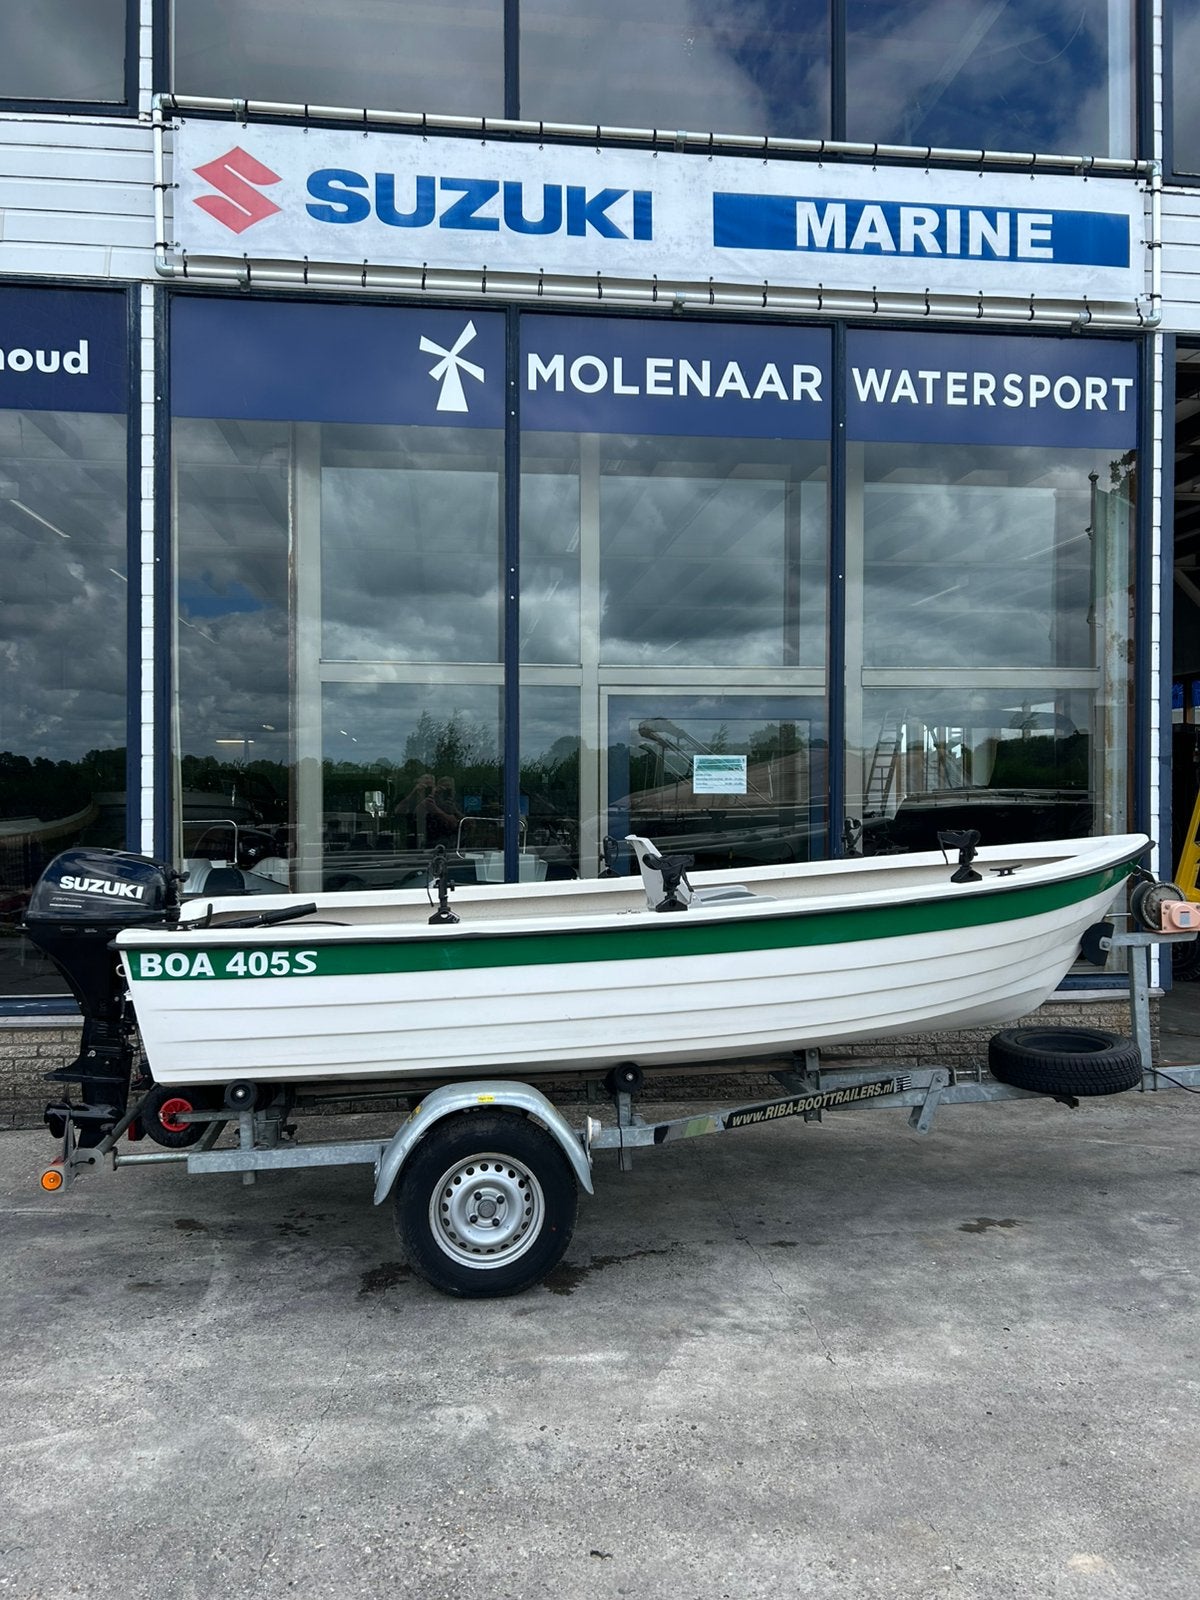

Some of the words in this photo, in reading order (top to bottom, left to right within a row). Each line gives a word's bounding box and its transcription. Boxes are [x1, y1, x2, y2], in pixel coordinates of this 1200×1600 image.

[305, 167, 653, 241] SUZUKI
[795, 201, 1054, 259] MARINE
[0, 339, 89, 375] oud
[527, 352, 823, 402] MOLENAAR
[852, 367, 1134, 412] WATERSPORT
[59, 875, 145, 900] SUZUKI
[140, 952, 215, 977] BOA
[225, 951, 318, 977] 405S
